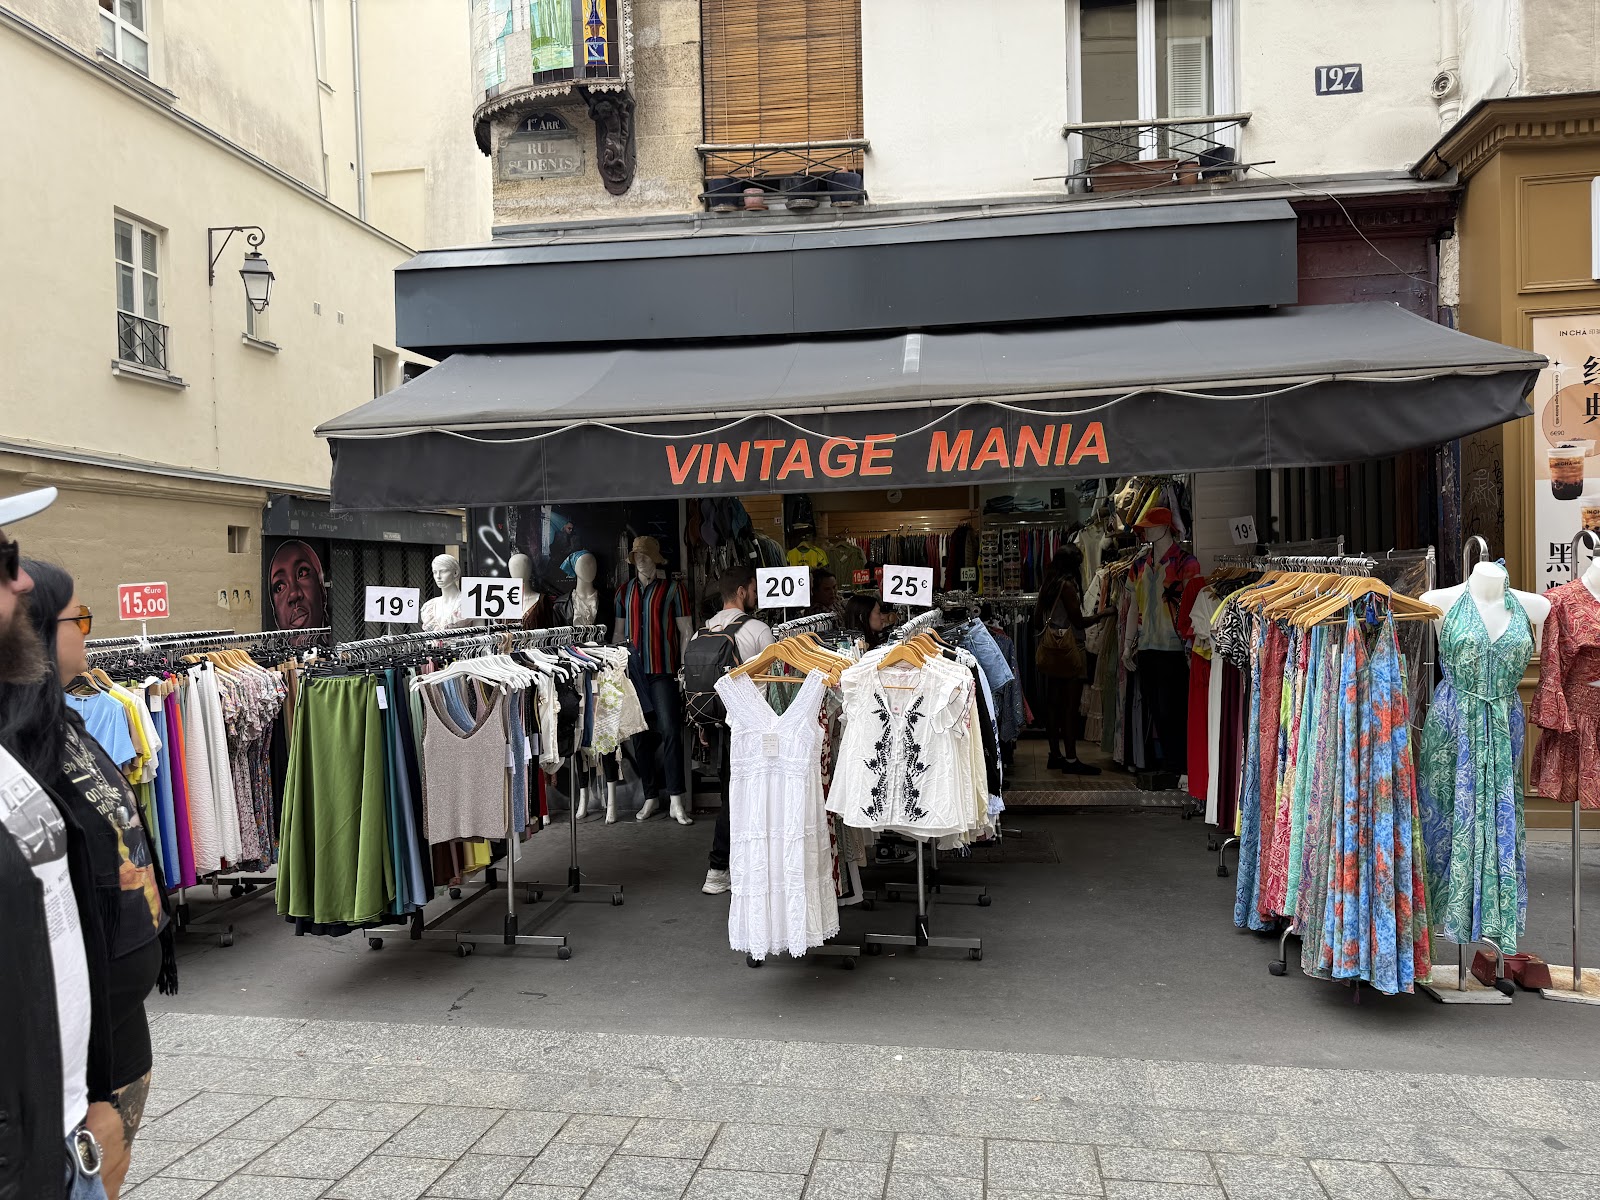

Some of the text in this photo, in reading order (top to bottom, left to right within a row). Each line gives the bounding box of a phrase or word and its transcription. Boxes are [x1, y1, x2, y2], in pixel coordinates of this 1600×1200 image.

[1319, 66, 1360, 92] 127
[527, 142, 556, 155] RUE
[527, 156, 573, 172] DENIS
[664, 421, 1110, 486] VINTAGE MANIA
[122, 591, 167, 616] 15,00
